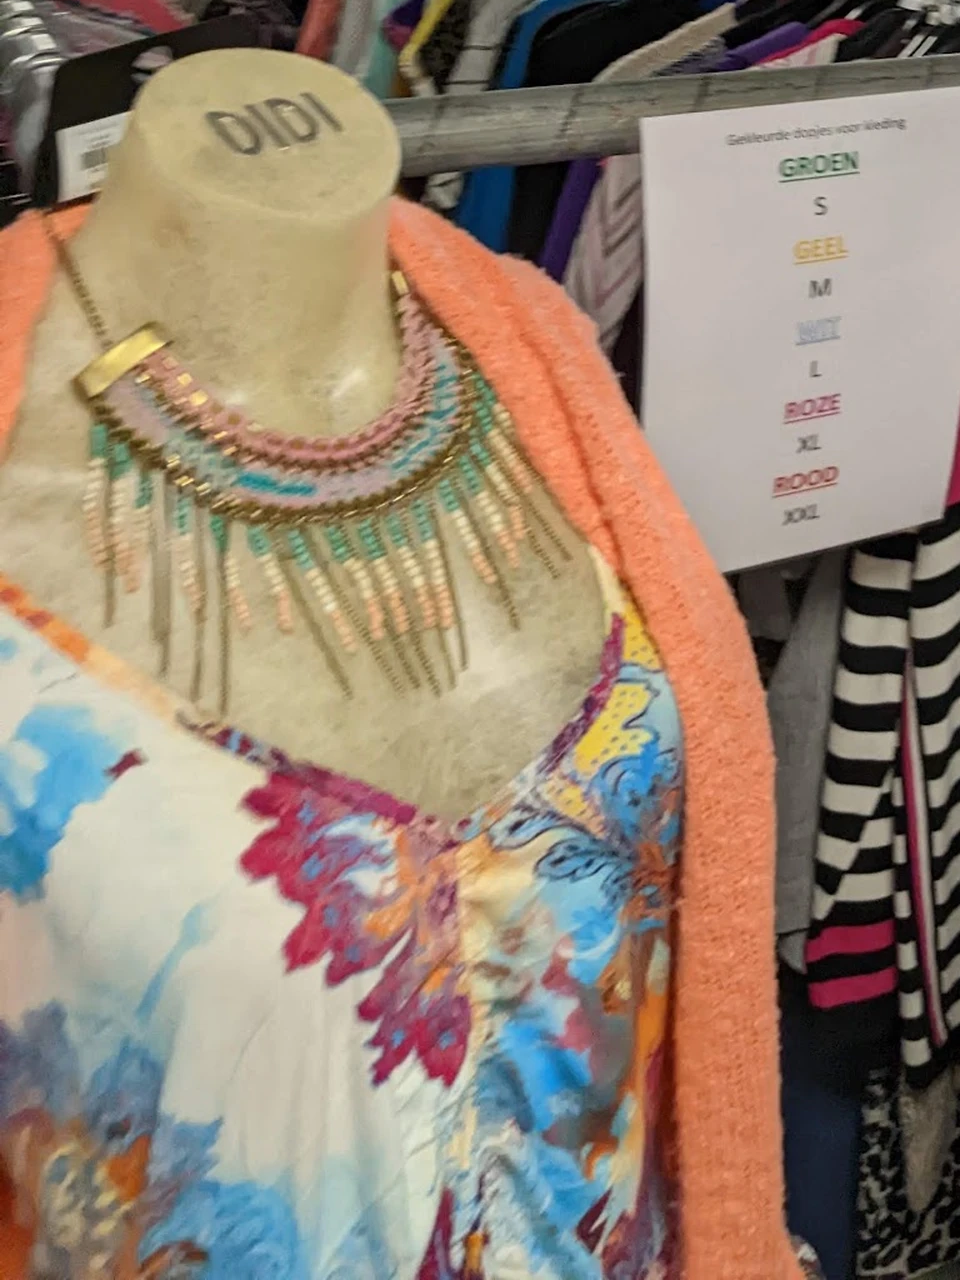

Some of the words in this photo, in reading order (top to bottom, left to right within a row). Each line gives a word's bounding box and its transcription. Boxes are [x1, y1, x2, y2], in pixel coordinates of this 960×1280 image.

[204, 92, 343, 156] DIDI
[778, 150, 860, 179] GROEN
[813, 195, 829, 216] S
[792, 235, 849, 261] GEEL
[808, 277, 832, 299] M
[808, 360, 823, 378] L
[783, 393, 842, 421] ROZE
[795, 433, 822, 454] XL
[772, 465, 840, 495] ROOD
[781, 503, 820, 526] XXL
